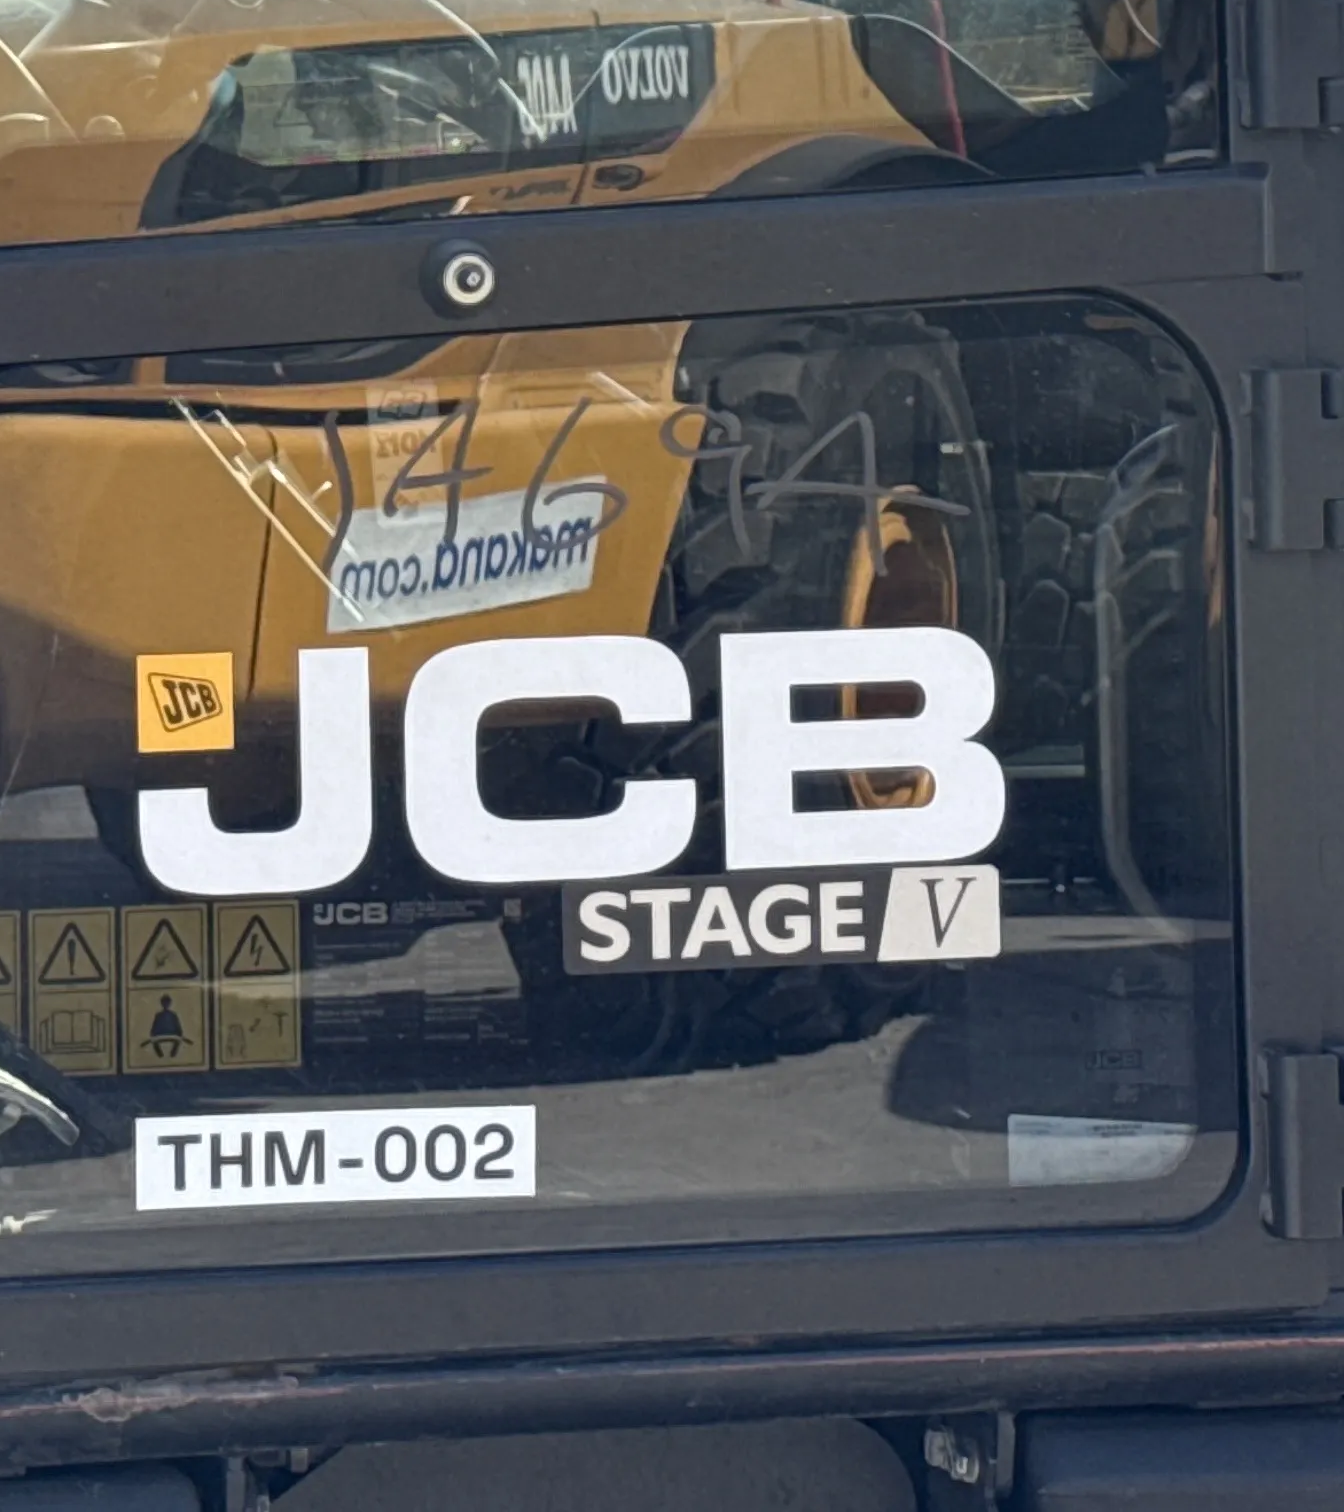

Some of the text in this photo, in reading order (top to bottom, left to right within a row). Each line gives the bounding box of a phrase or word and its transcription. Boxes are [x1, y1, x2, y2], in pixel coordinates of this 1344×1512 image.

[161, 678, 218, 726] JCB
[137, 625, 1006, 897] JCB
[312, 901, 389, 926] JCB
[577, 875, 976, 963] STAGE V
[158, 1122, 517, 1192] THM-002
